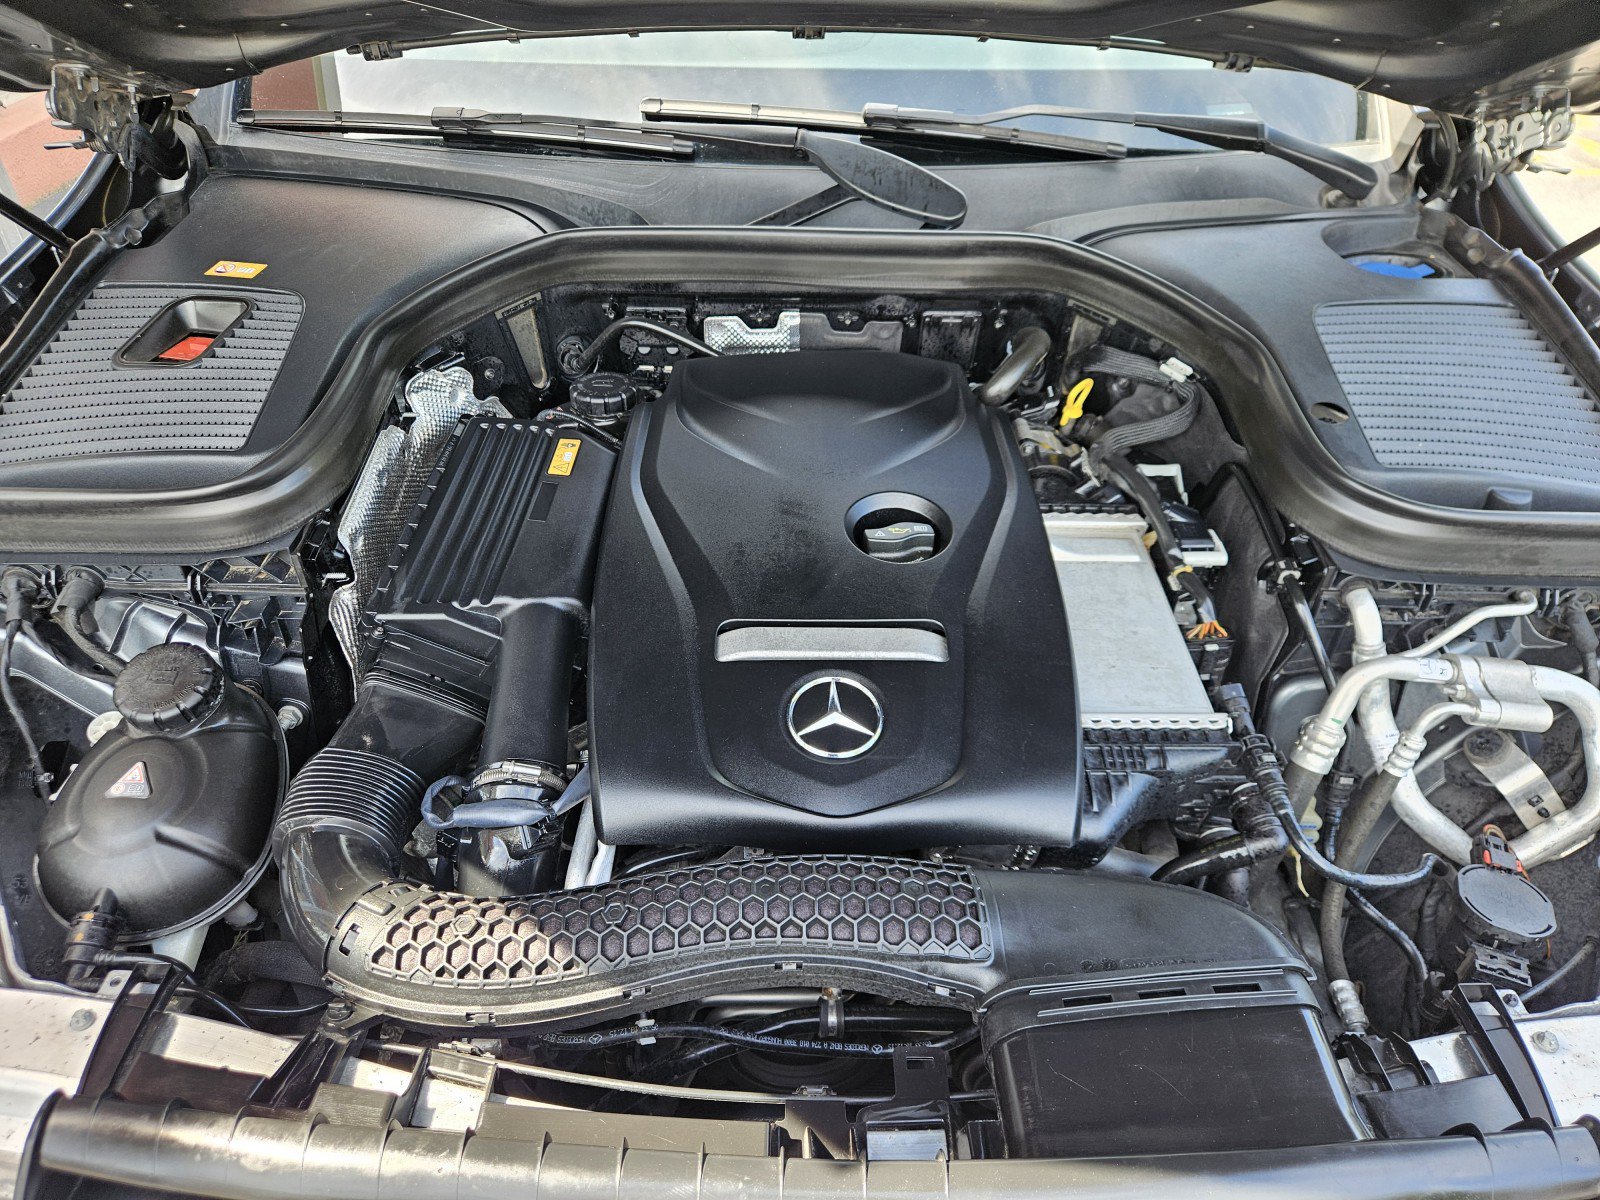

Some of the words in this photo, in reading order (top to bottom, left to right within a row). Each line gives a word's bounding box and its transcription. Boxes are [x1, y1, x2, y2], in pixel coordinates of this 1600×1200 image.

[557, 1035, 586, 1044] MERCEDES
[829, 1042, 843, 1051] BENZ
[845, 1043, 869, 1052] MERCEDES
